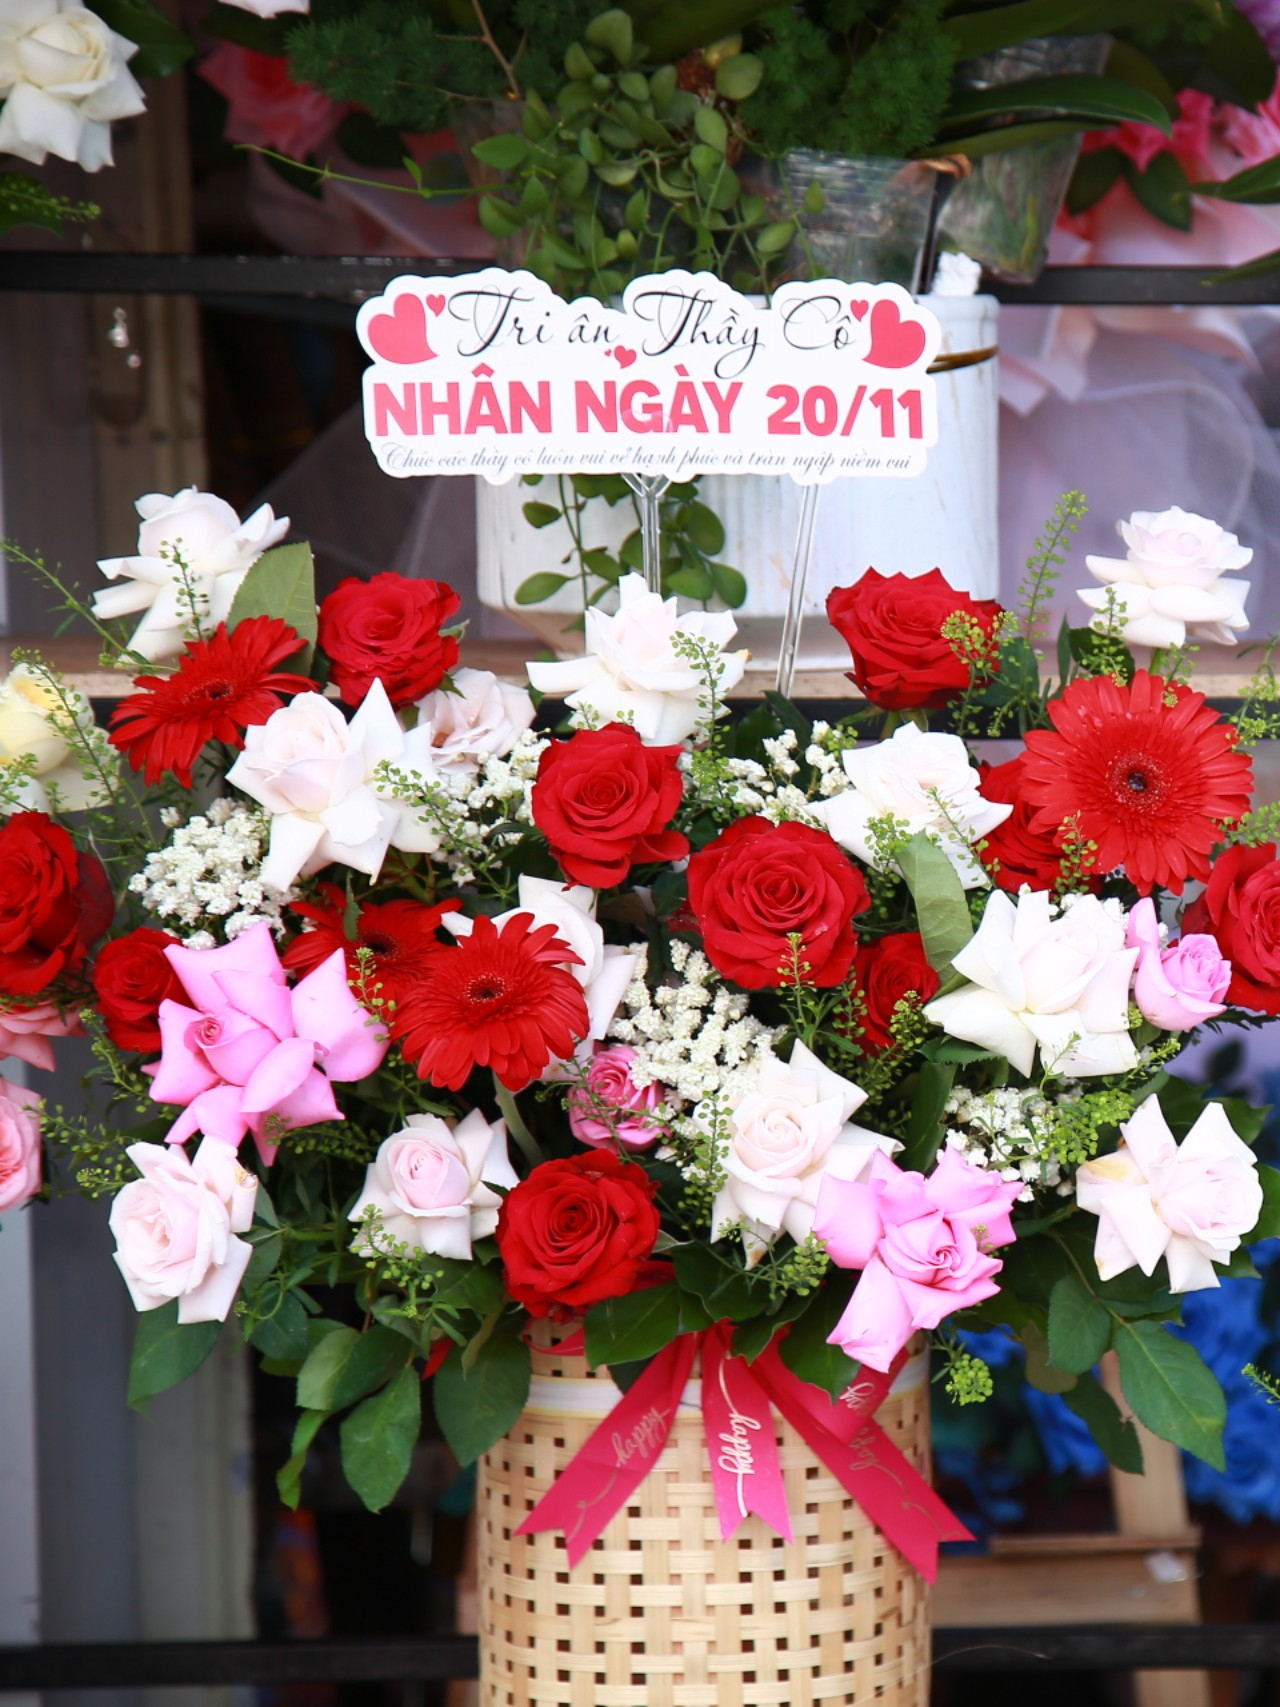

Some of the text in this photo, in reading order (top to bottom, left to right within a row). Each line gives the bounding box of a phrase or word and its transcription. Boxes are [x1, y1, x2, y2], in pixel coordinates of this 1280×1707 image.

[448, 284, 857, 379] Tri ân Thầy Cô
[373, 362, 924, 439] NHÂN NGÀY 20/11
[381, 442, 434, 470] Chúc
[438, 450, 467, 468] các
[470, 446, 509, 475] thầy
[514, 455, 534, 467] cô
[537, 447, 574, 466] luôn
[579, 451, 606, 465] vui
[676, 447, 719, 474] phúc
[723, 449, 744, 465] và
[748, 448, 786, 466] tràn
[792, 450, 836, 475] ngập
[840, 447, 881, 468] niềm
[885, 455, 912, 469] vui
[611, 1407, 671, 1468] happy
[717, 1411, 762, 1475] happy
